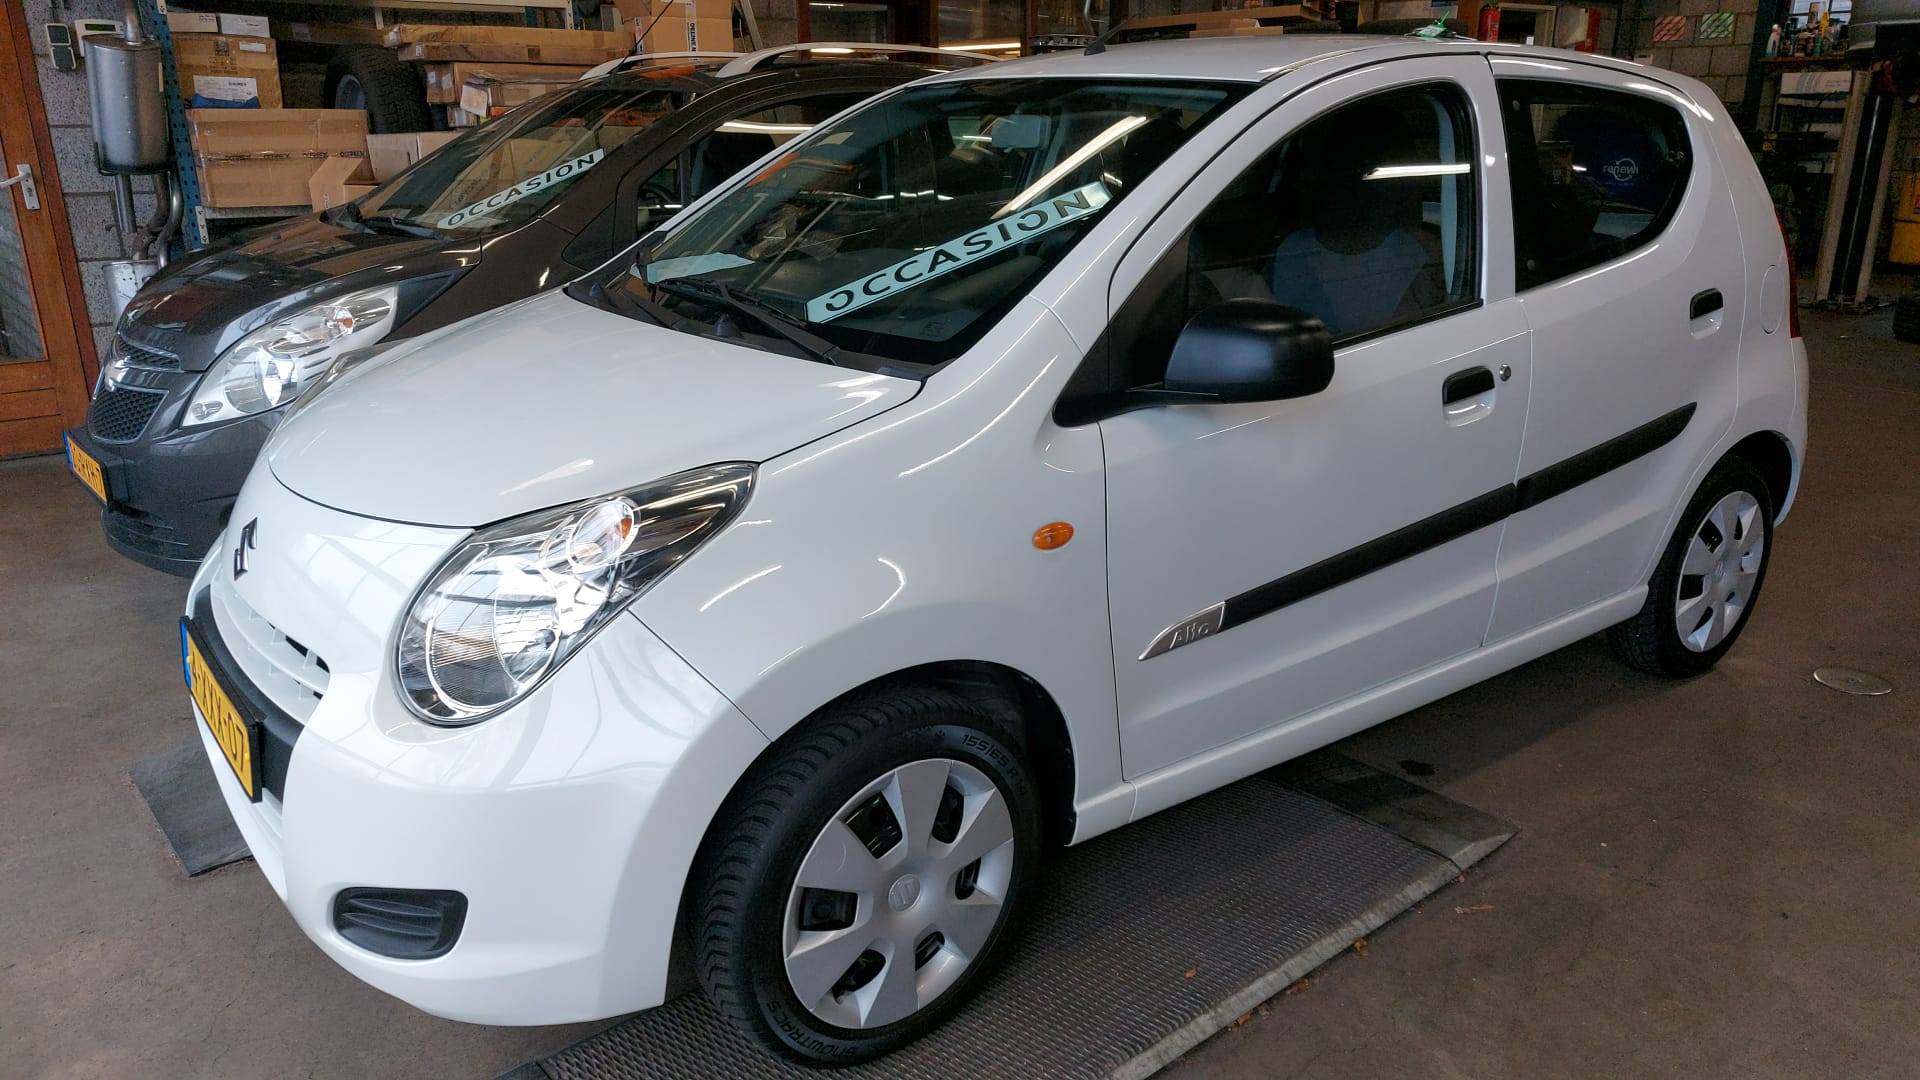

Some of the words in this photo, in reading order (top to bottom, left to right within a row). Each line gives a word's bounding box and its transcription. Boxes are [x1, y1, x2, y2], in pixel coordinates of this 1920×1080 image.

[447, 153, 595, 226] OCCASION
[825, 191, 1091, 312] OCCASION
[1169, 622, 1209, 649] Alto
